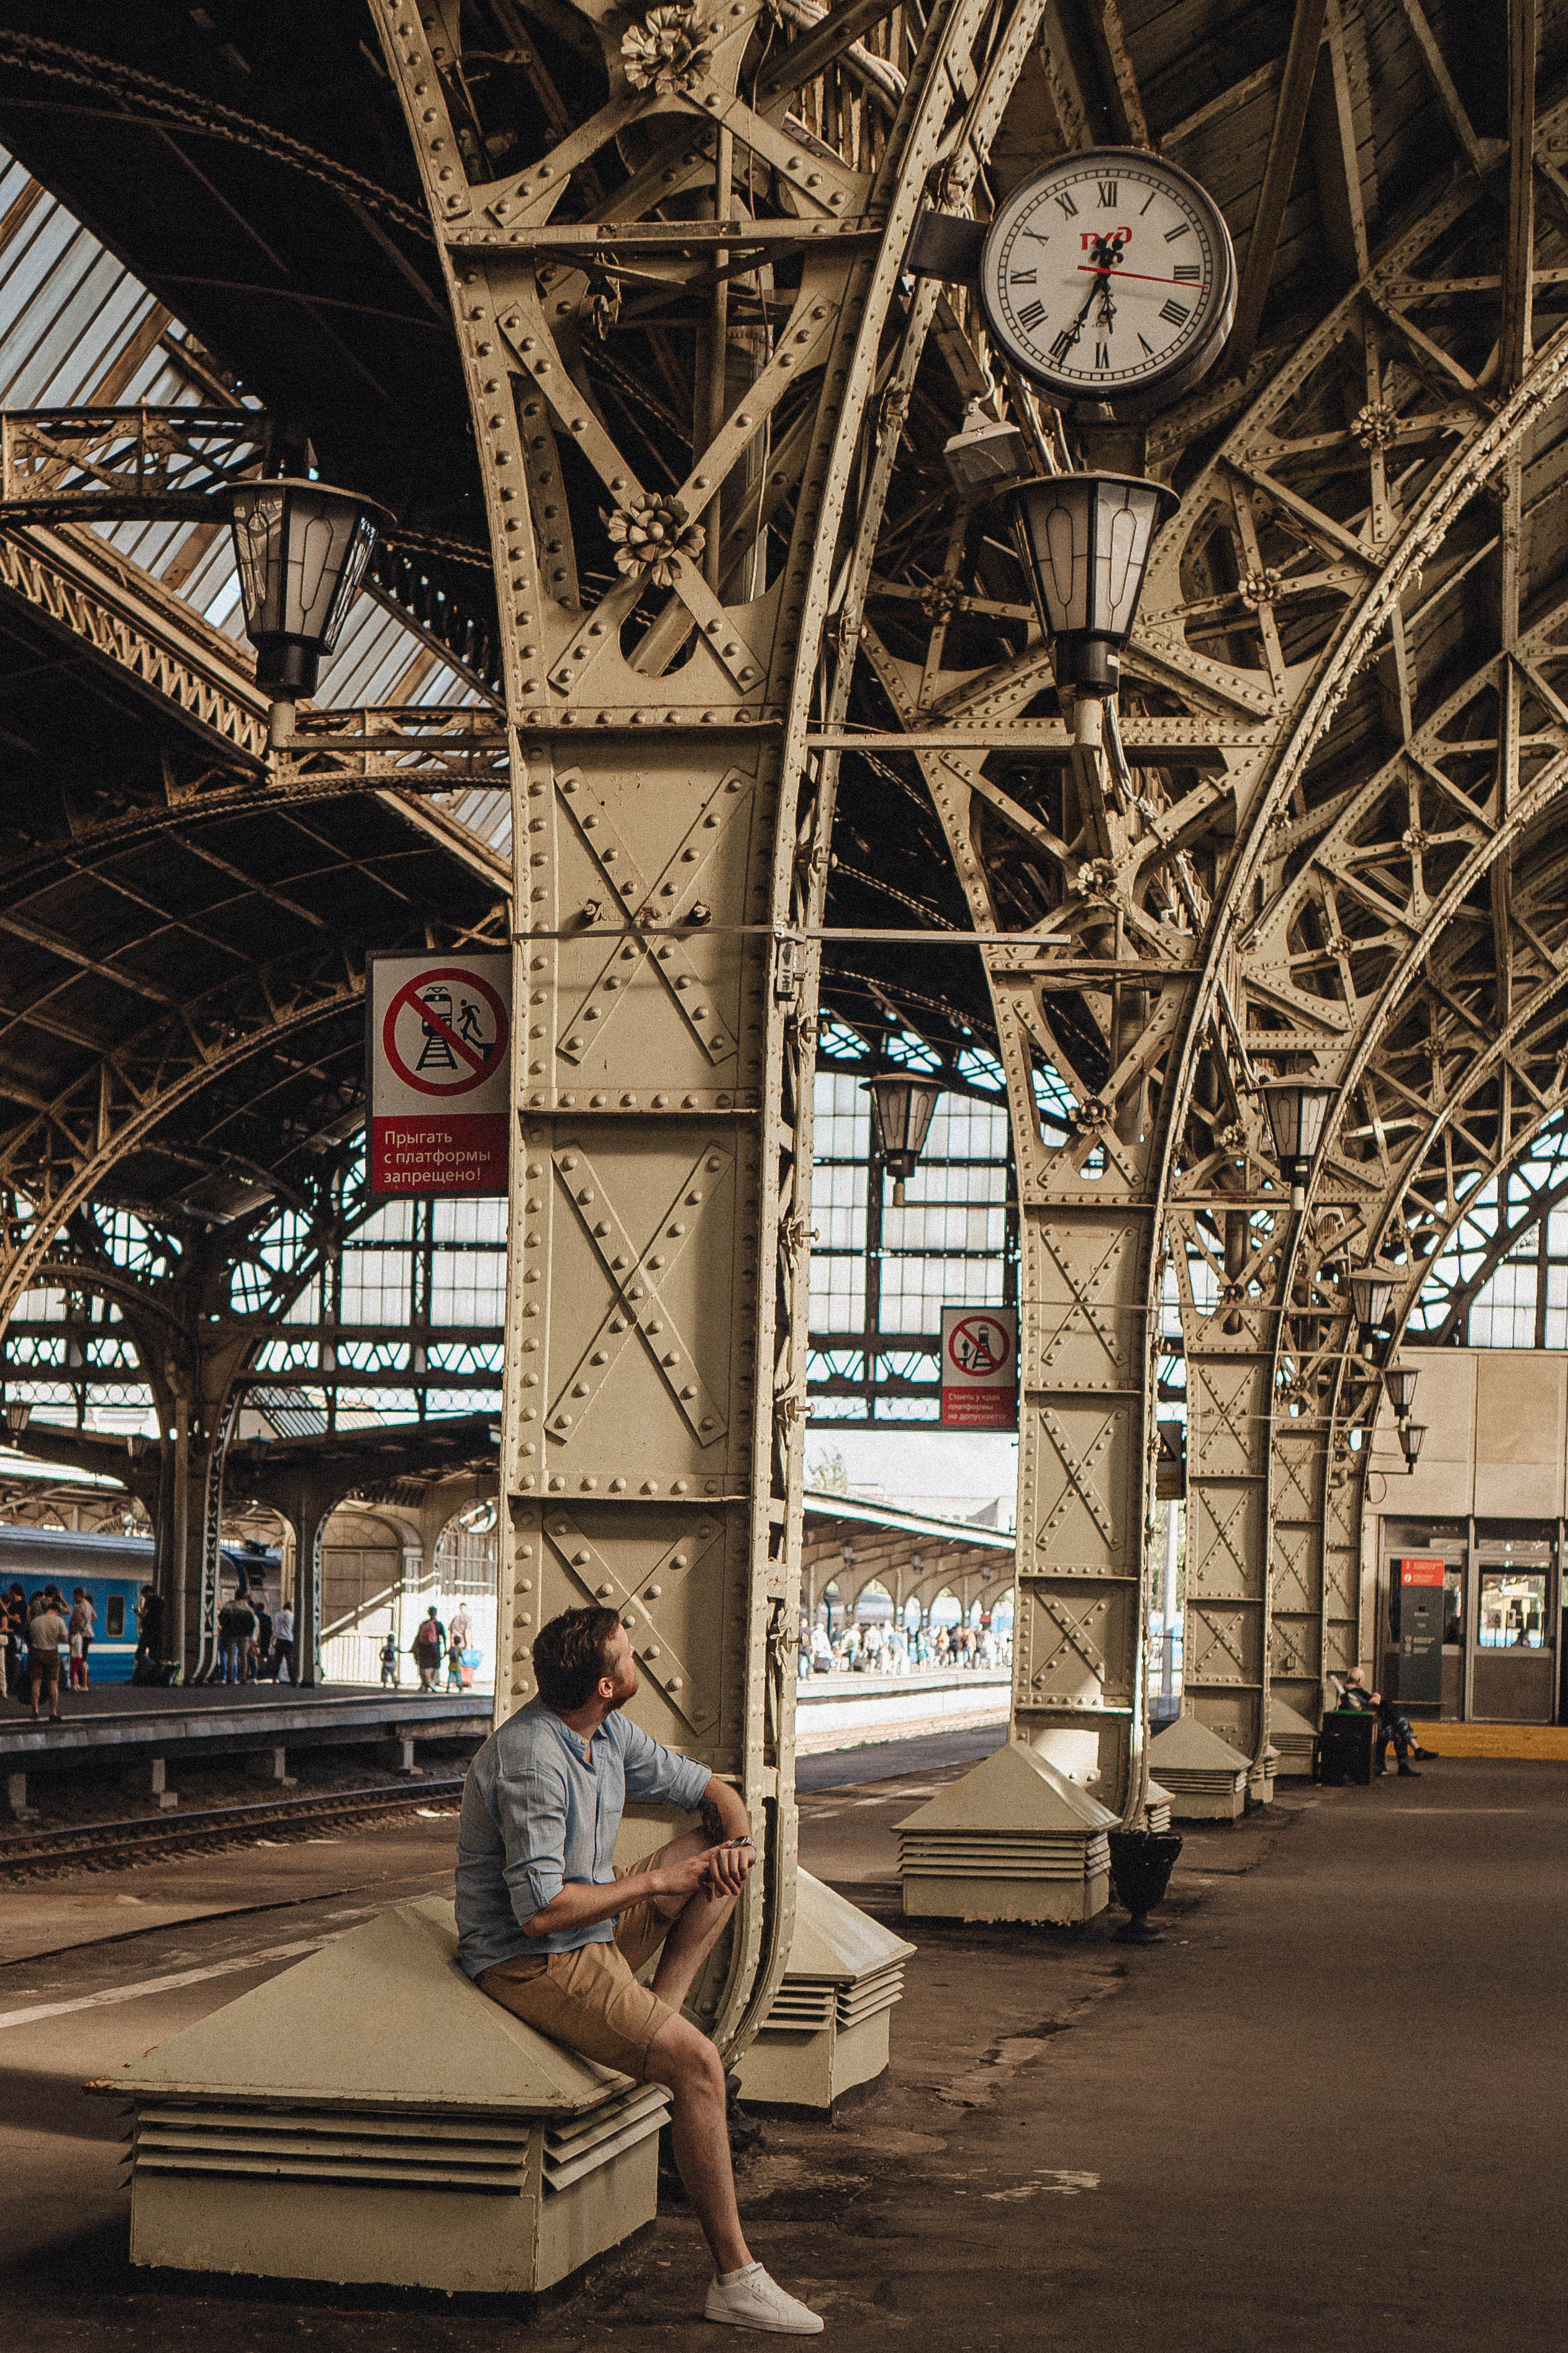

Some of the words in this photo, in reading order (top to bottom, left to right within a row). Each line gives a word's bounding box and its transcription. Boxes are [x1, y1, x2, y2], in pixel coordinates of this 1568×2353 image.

[1053, 190, 1079, 221] XI
[1097, 181, 1118, 208] XII
[1139, 192, 1156, 216] I
[1022, 225, 1049, 247] X
[1163, 222, 1191, 243] II
[1010, 268, 1037, 284] IX
[1173, 265, 1200, 280] III
[1017, 299, 1049, 333] VIII
[1095, 342, 1110, 369] VI
[1137, 332, 1154, 358] V
[385, 1131, 453, 1148] Прыгать
[384, 1153, 392, 1163] с
[396, 1149, 491, 1166] платформы
[384, 1167, 481, 1186] запрещено!
